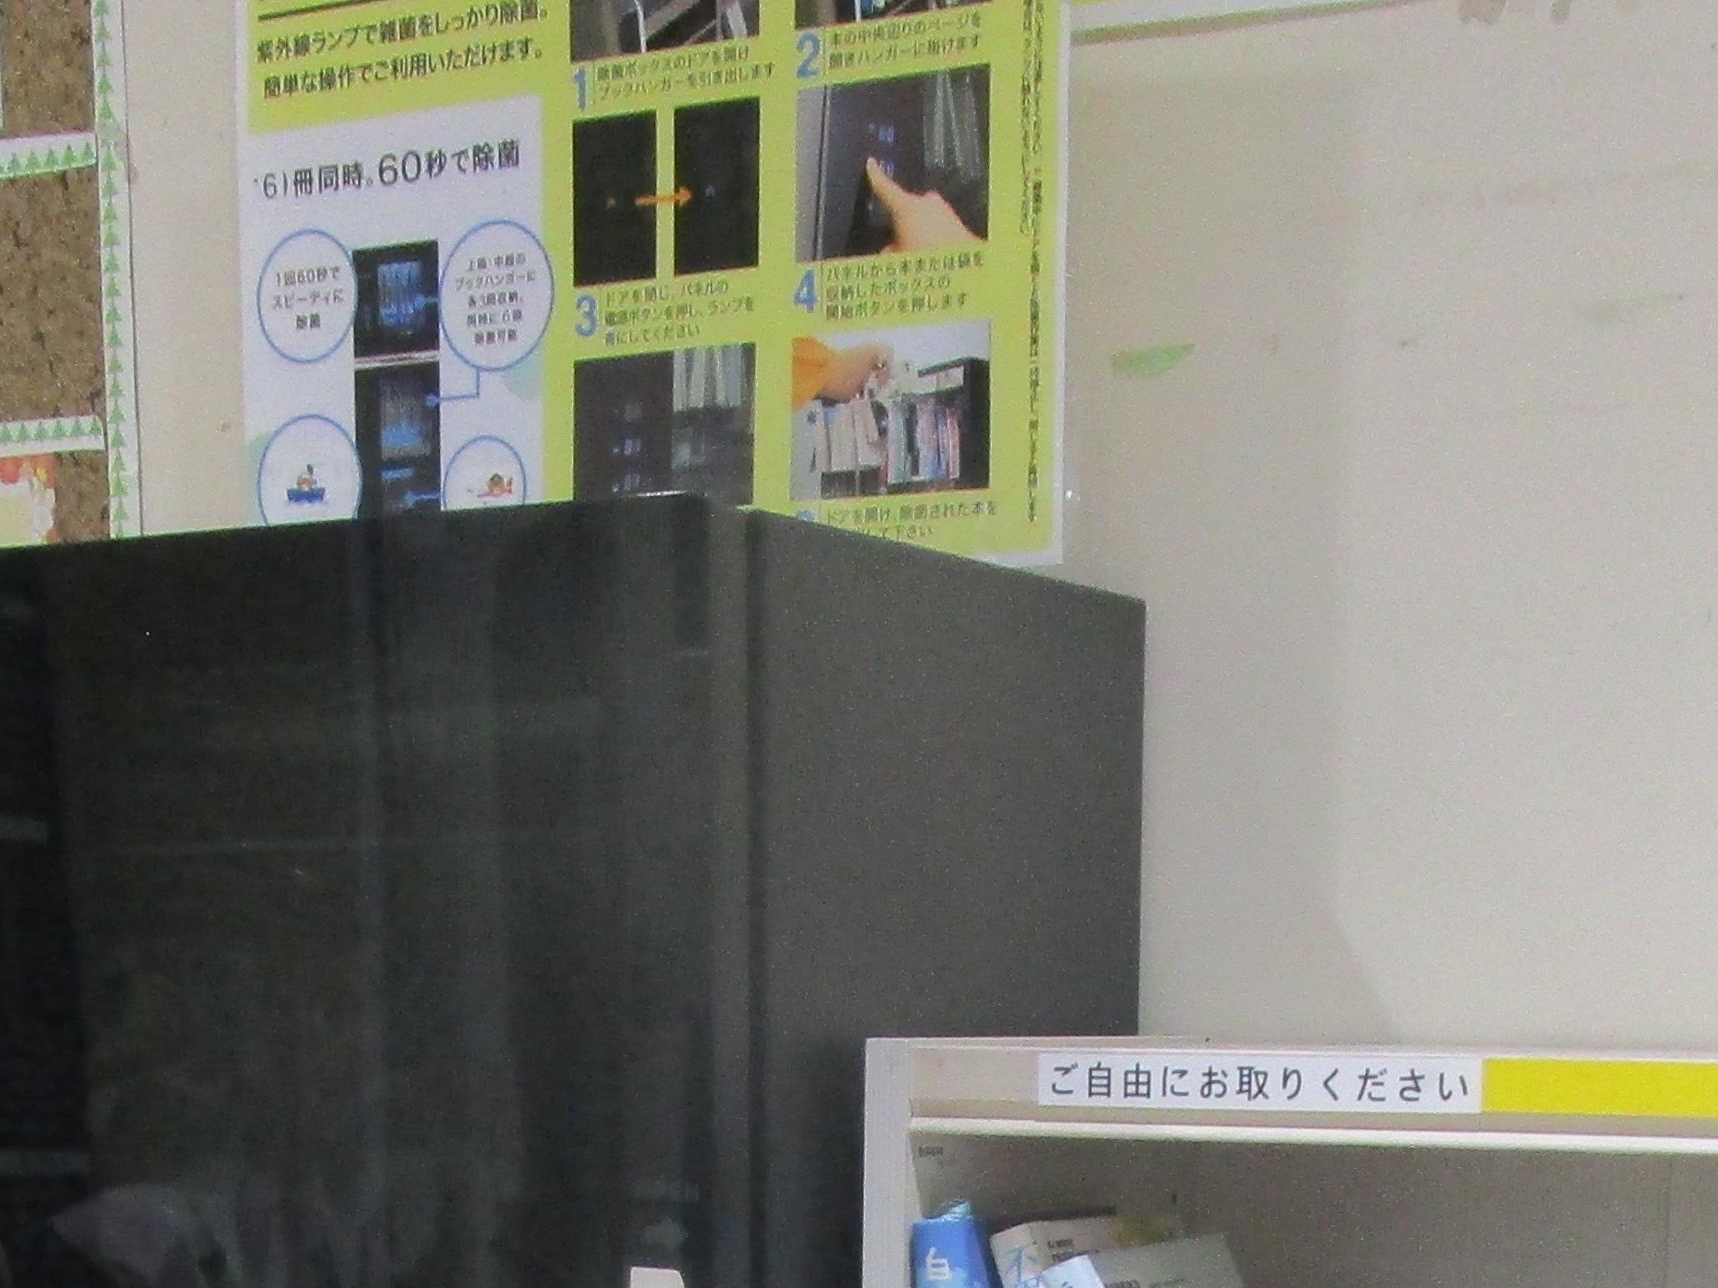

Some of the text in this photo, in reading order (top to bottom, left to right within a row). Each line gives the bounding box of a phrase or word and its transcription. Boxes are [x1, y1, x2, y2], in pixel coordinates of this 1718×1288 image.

[264, 36, 542, 99] 簡単な操作でご利用いただけます。
[796, 32, 822, 78] 2
[572, 67, 587, 112] 1
[793, 269, 819, 313] 4
[575, 294, 598, 337] 3
[1051, 1061, 1468, 1102] ご自由にお取りください
